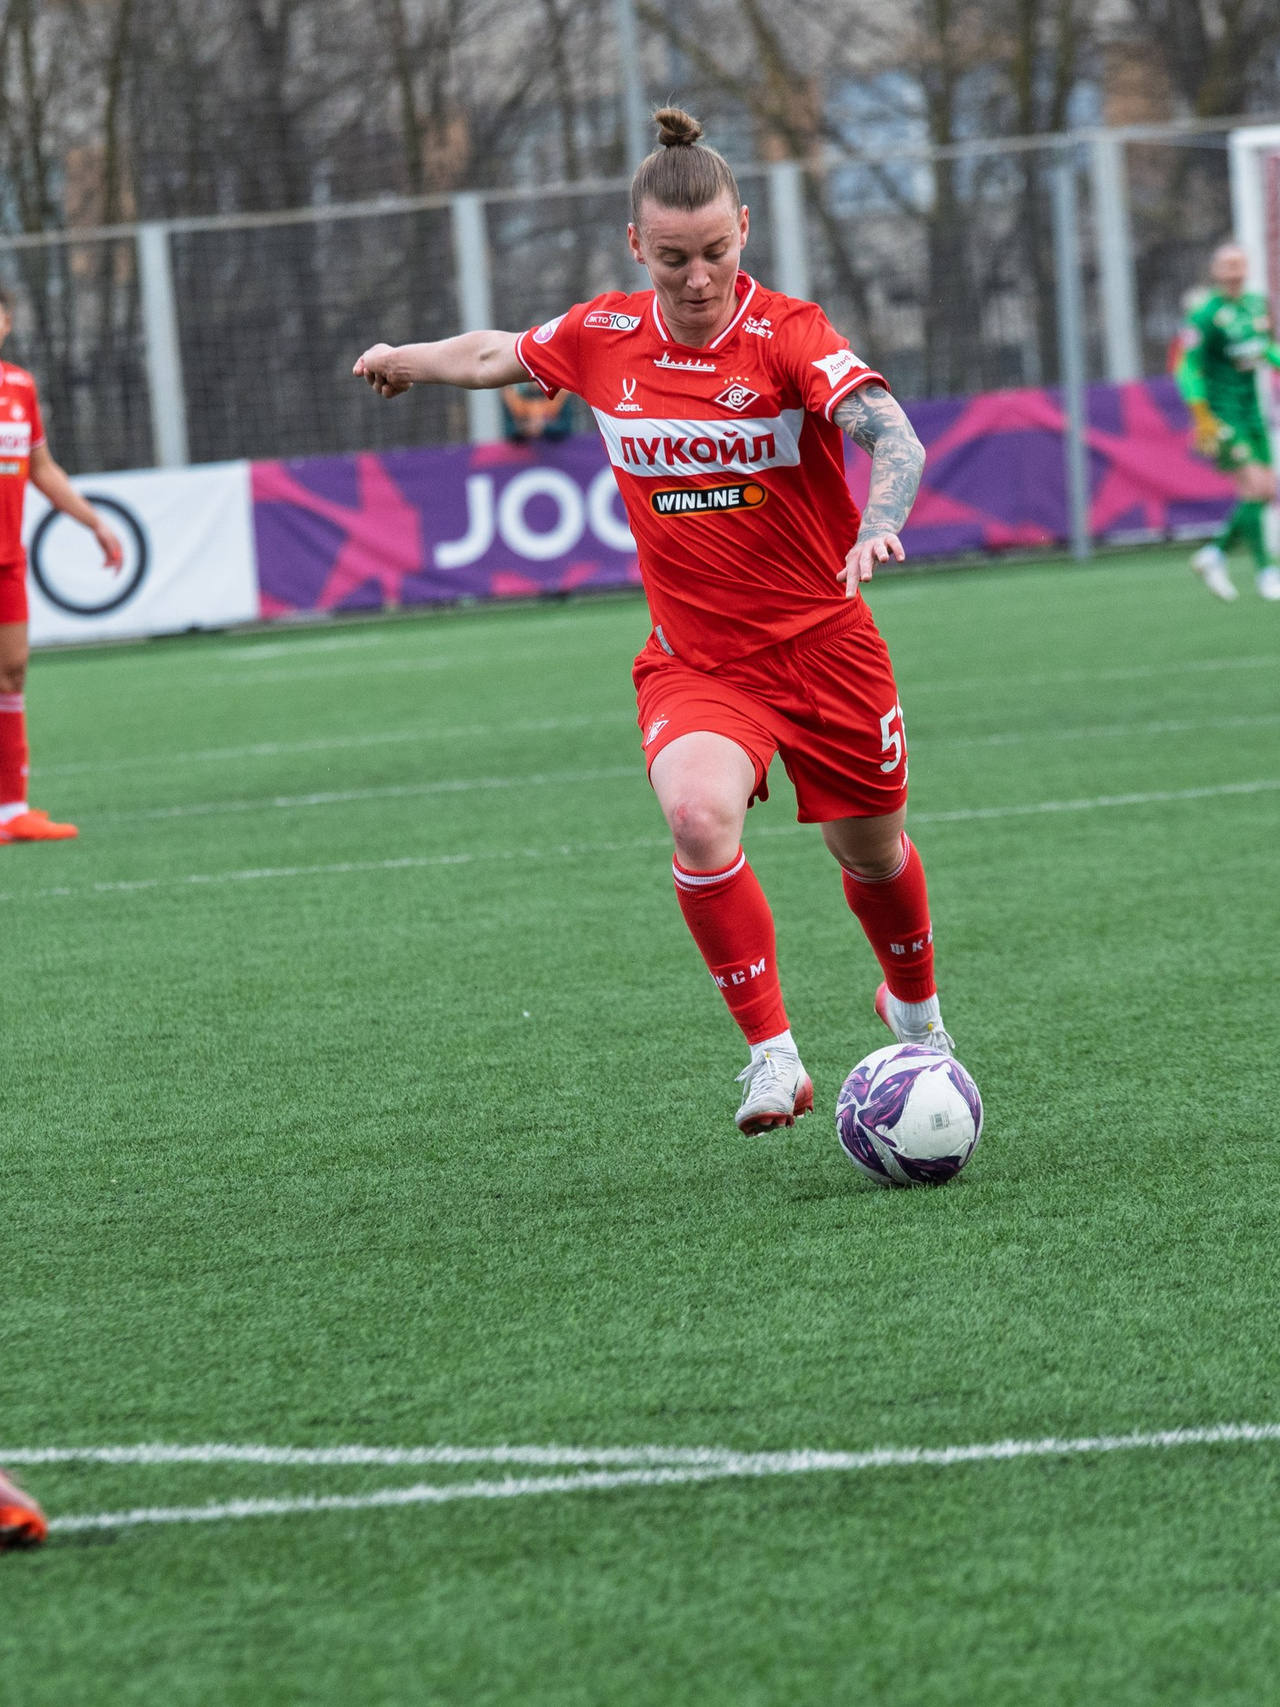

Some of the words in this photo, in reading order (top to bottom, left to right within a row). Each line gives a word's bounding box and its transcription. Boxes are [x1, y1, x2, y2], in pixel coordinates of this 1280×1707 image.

[620, 431, 776, 466] ЛУКОЙЛ
[656, 488, 740, 512] WINLINE
[710, 957, 766, 988] КСМ
